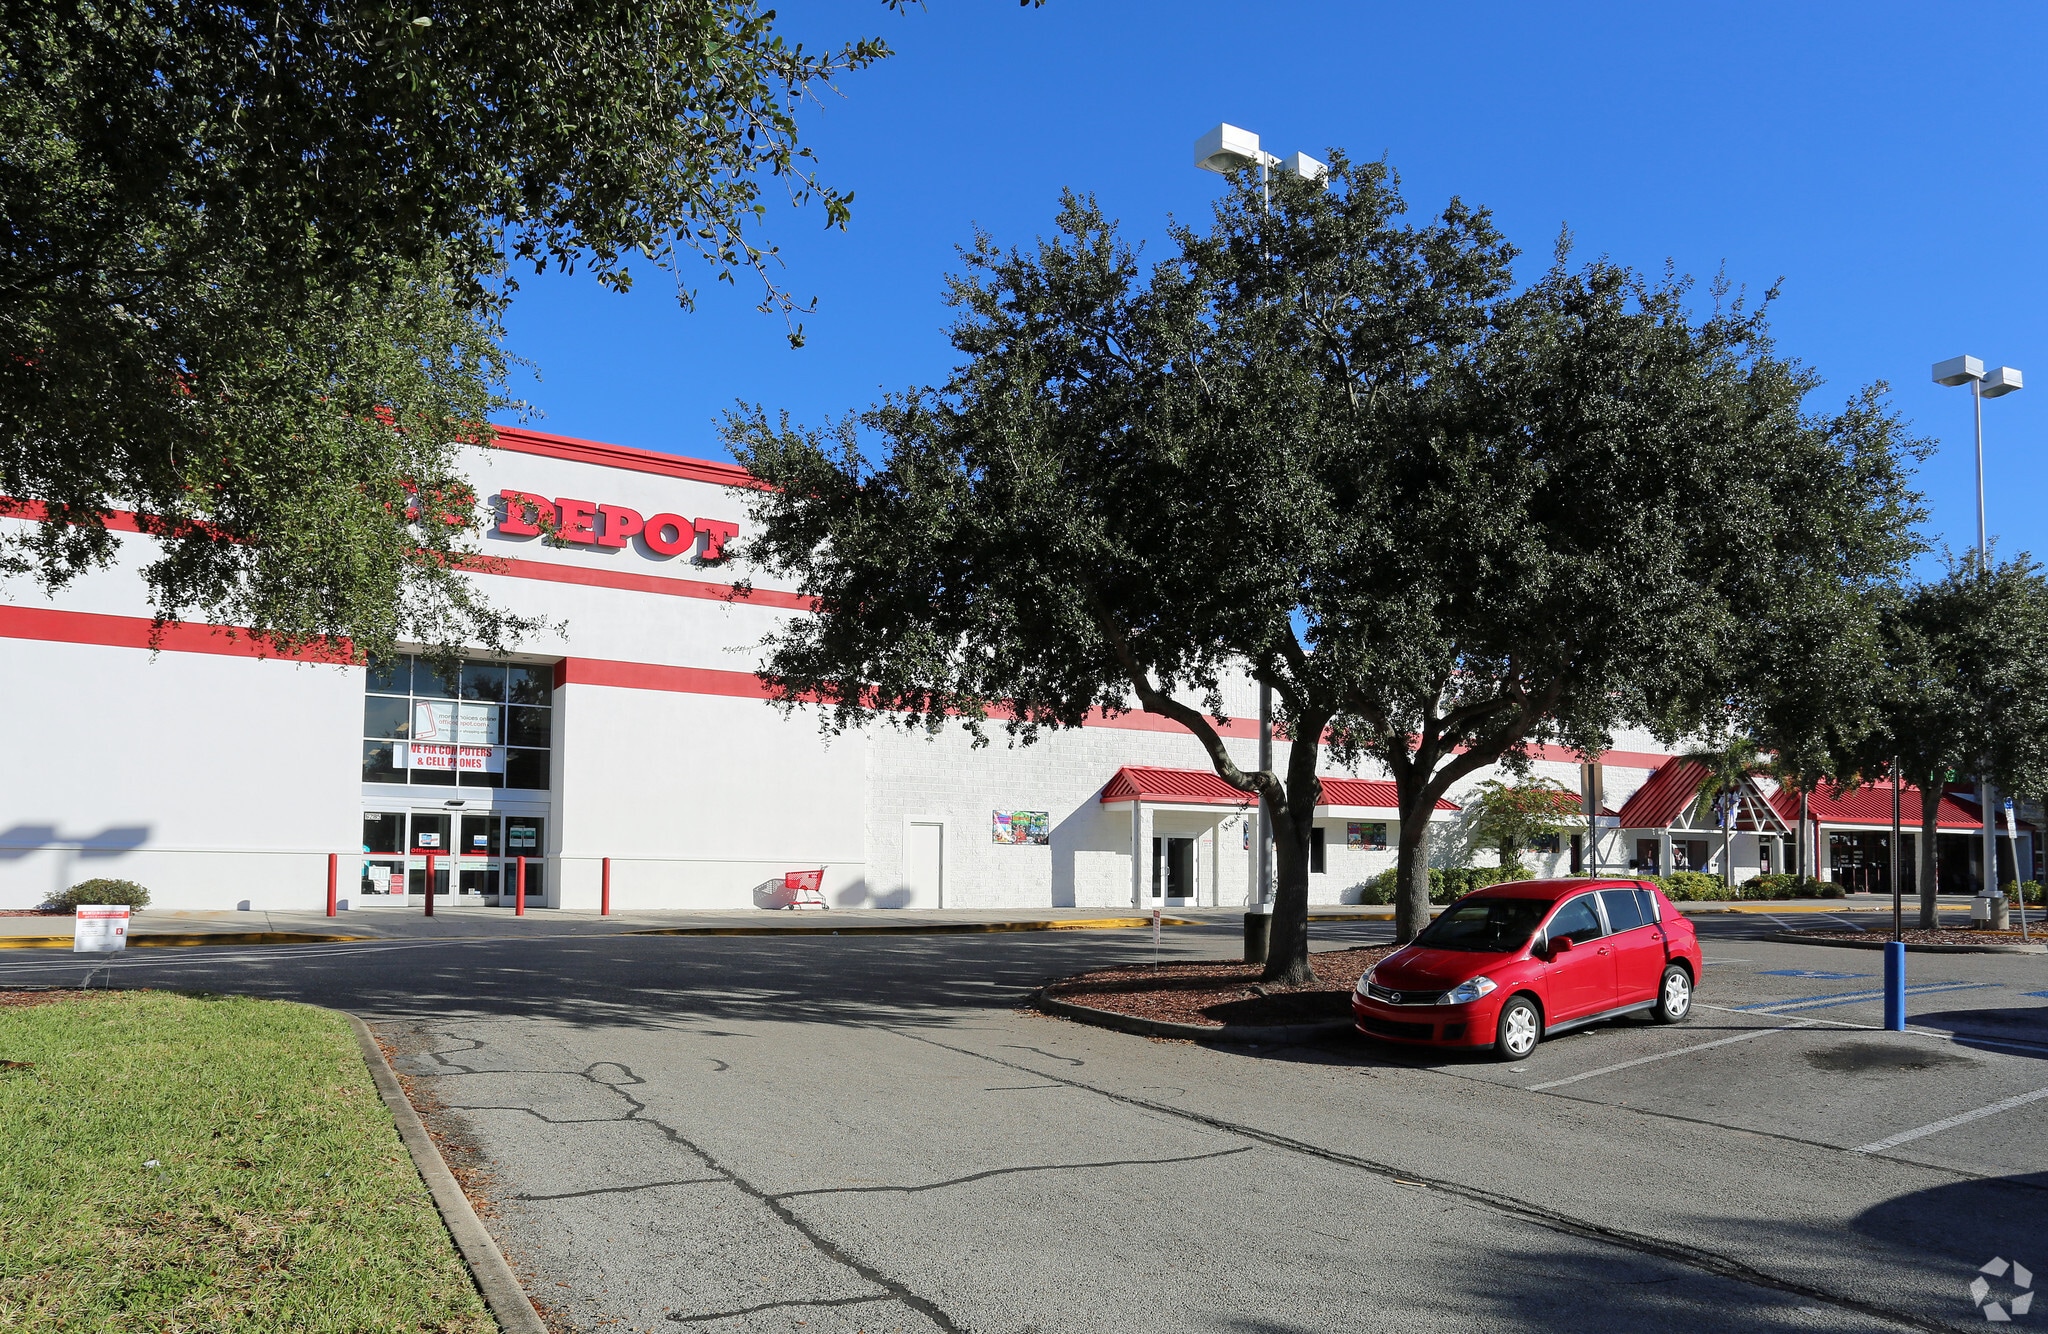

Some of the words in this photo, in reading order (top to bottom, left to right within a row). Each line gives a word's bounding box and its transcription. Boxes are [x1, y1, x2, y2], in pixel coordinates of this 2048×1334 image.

[500, 489, 739, 560] DEPOT
[423, 744, 437, 754] FIX
[417, 756, 424, 765] &
[425, 756, 446, 767] CELL
